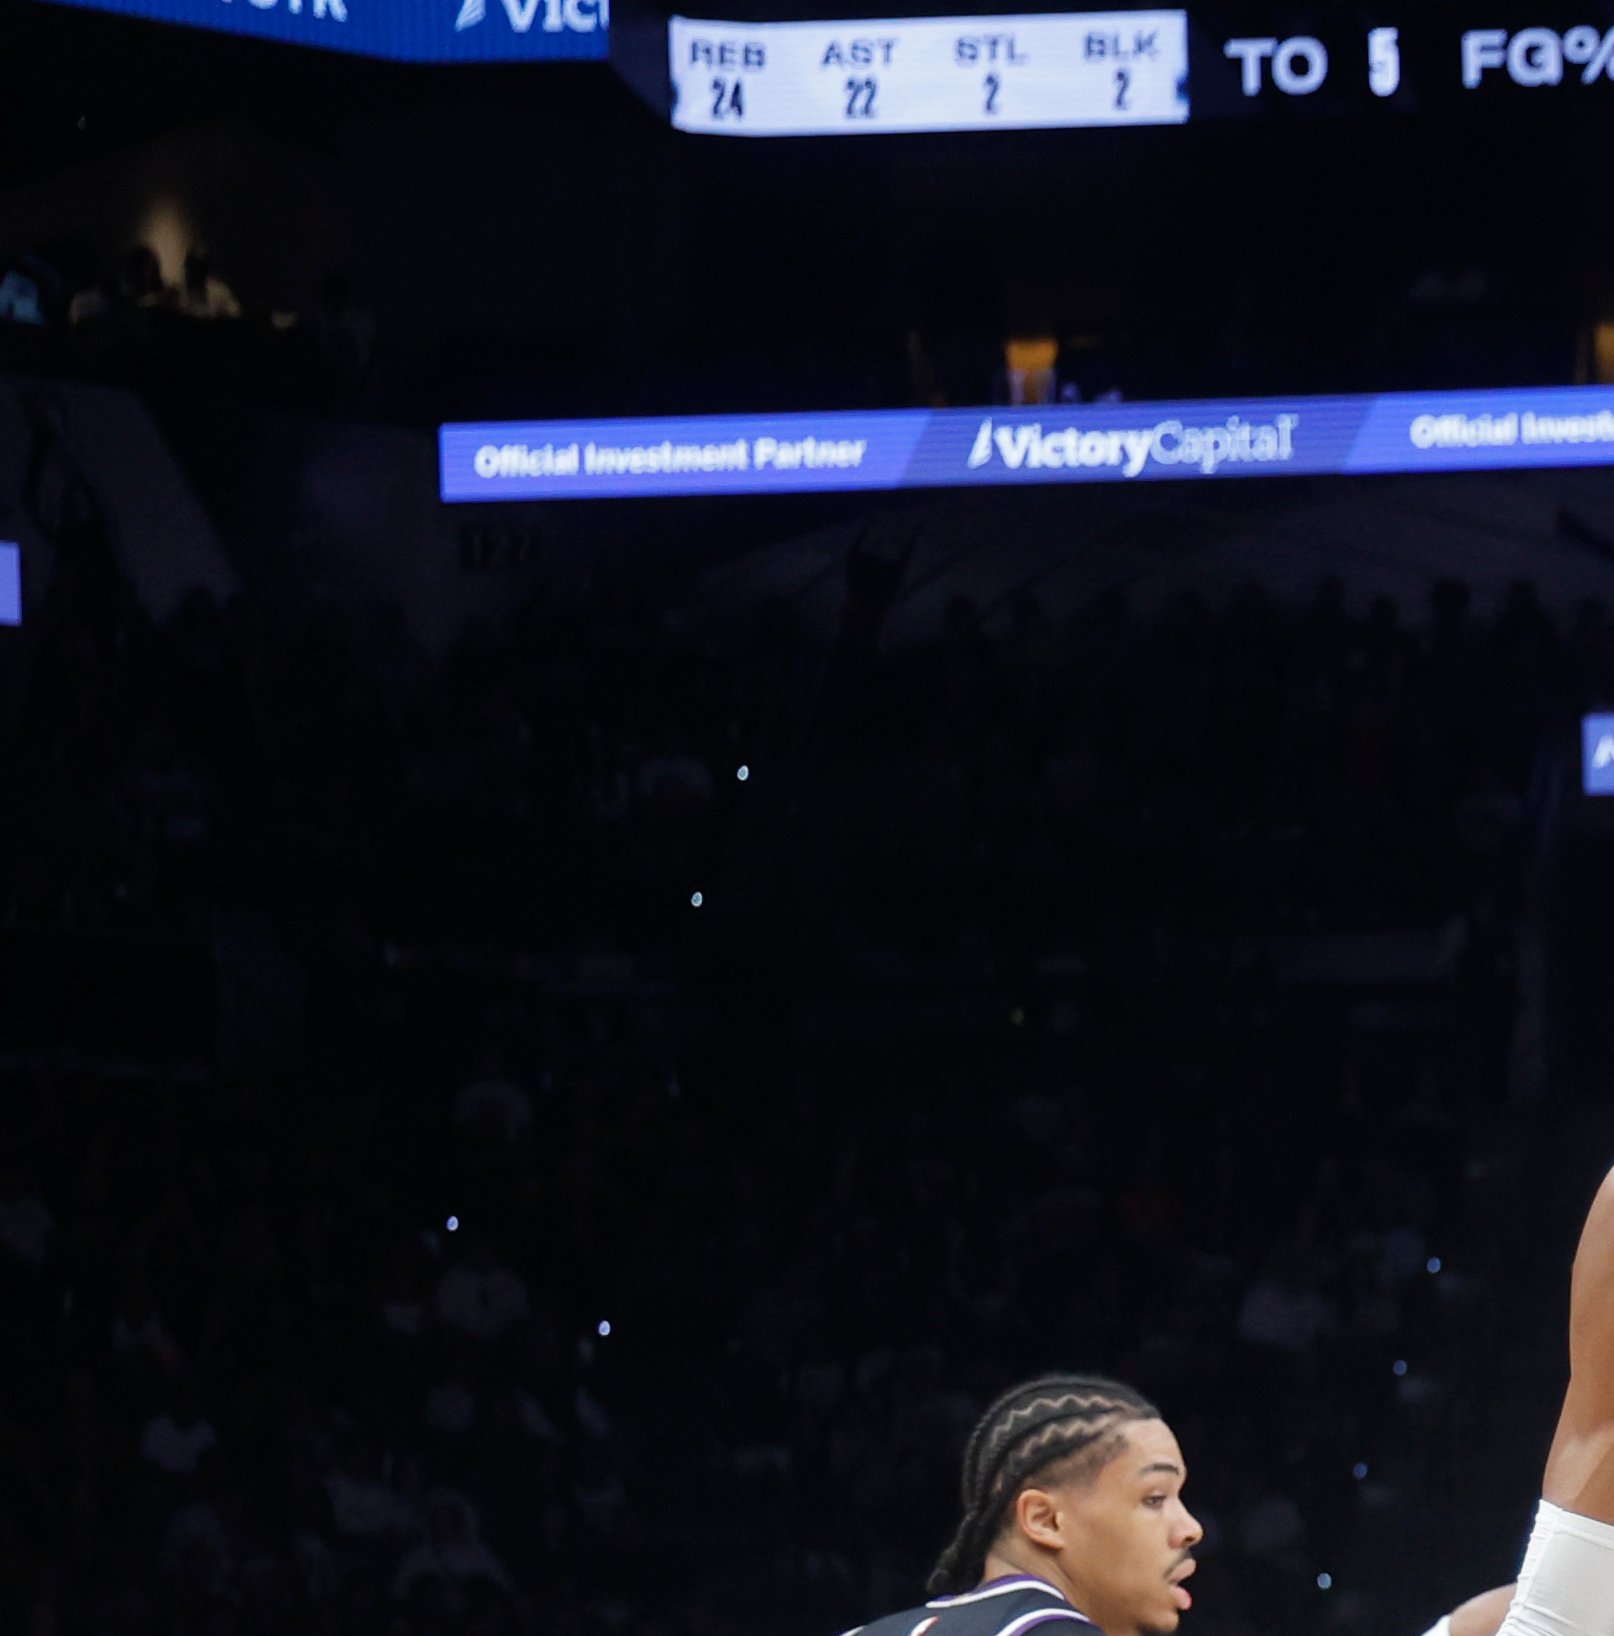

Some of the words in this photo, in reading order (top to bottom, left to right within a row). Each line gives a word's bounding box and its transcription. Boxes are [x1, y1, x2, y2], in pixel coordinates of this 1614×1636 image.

[689, 40, 767, 68] REB
[822, 38, 897, 66] AST
[955, 34, 1027, 64] STL
[1083, 30, 1159, 60] BLK
[1225, 36, 1328, 96] TO
[710, 75, 744, 119] 24
[845, 76, 879, 118] 22
[983, 71, 1001, 115] 2
[1113, 67, 1131, 111] 2
[1410, 412, 1517, 448] Official
[473, 442, 578, 479] Official
[584, 438, 747, 476] Investment
[753, 435, 867, 471] Partner
